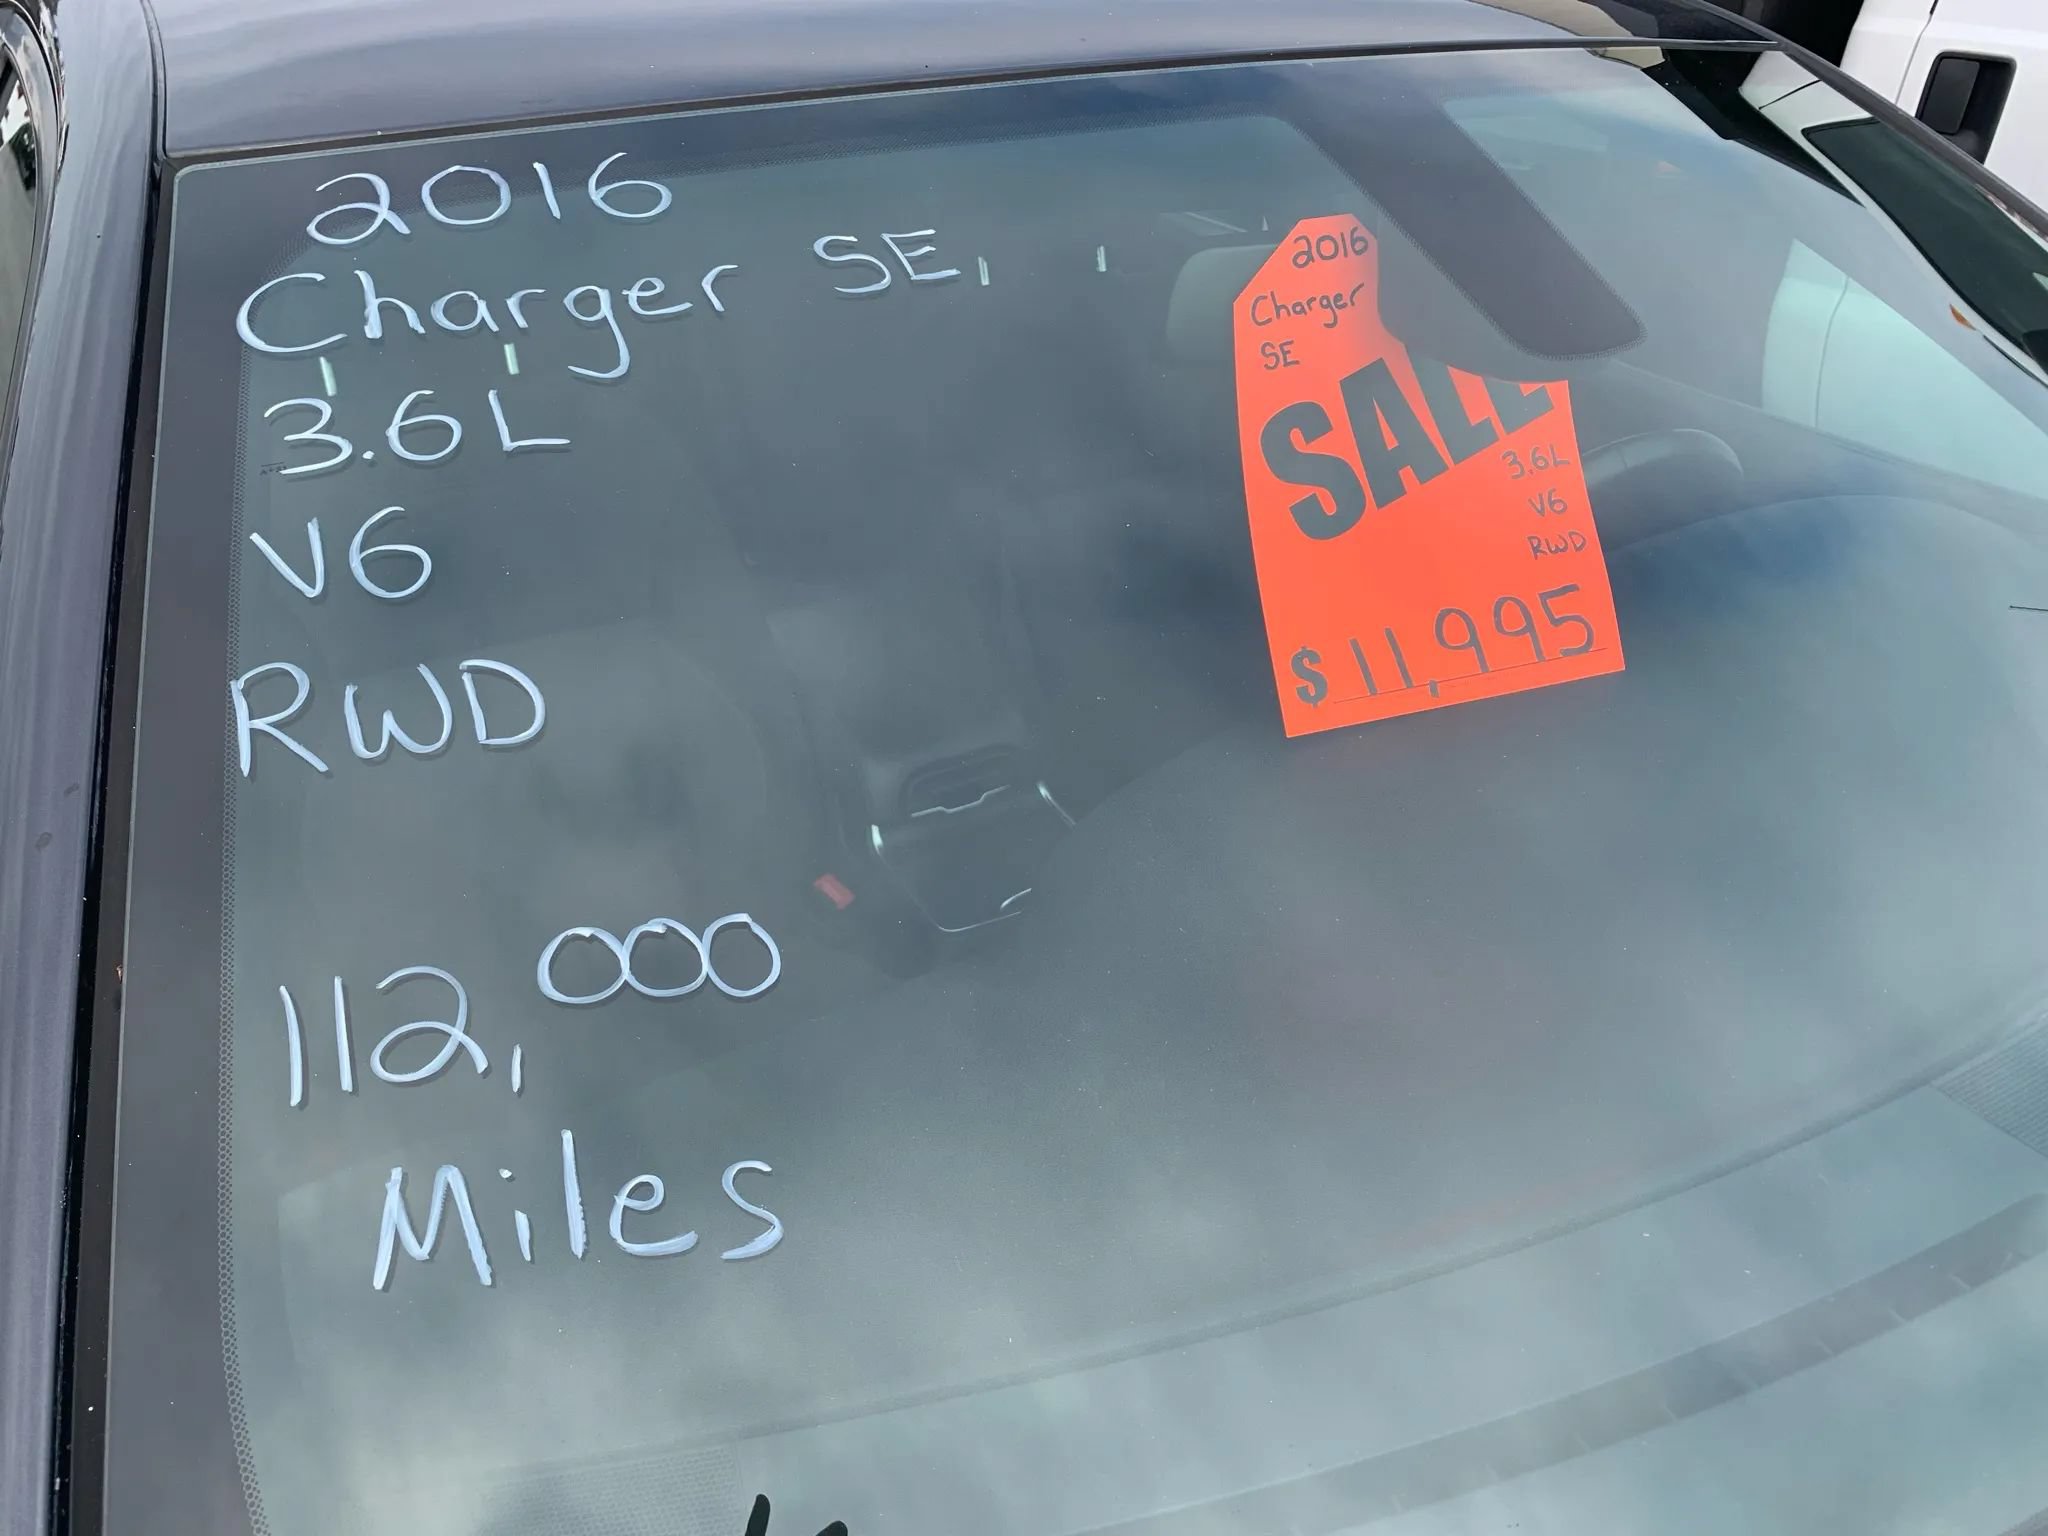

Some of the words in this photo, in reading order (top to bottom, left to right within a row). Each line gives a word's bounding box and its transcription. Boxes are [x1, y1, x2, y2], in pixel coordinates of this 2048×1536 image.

[306, 152, 672, 245] 2016
[1291, 226, 1369, 268] 2016
[236, 265, 738, 379] Charger
[1251, 283, 1365, 328] Charger
[1260, 340, 1300, 370] SE
[264, 390, 571, 475] 3.6L
[1501, 444, 1570, 479] 3.6L
[1528, 487, 1568, 517] V6
[249, 506, 432, 598] V6
[1526, 531, 1587, 560] RWD
[230, 659, 546, 777] RWD
[372, 1129, 784, 1290] Miles
